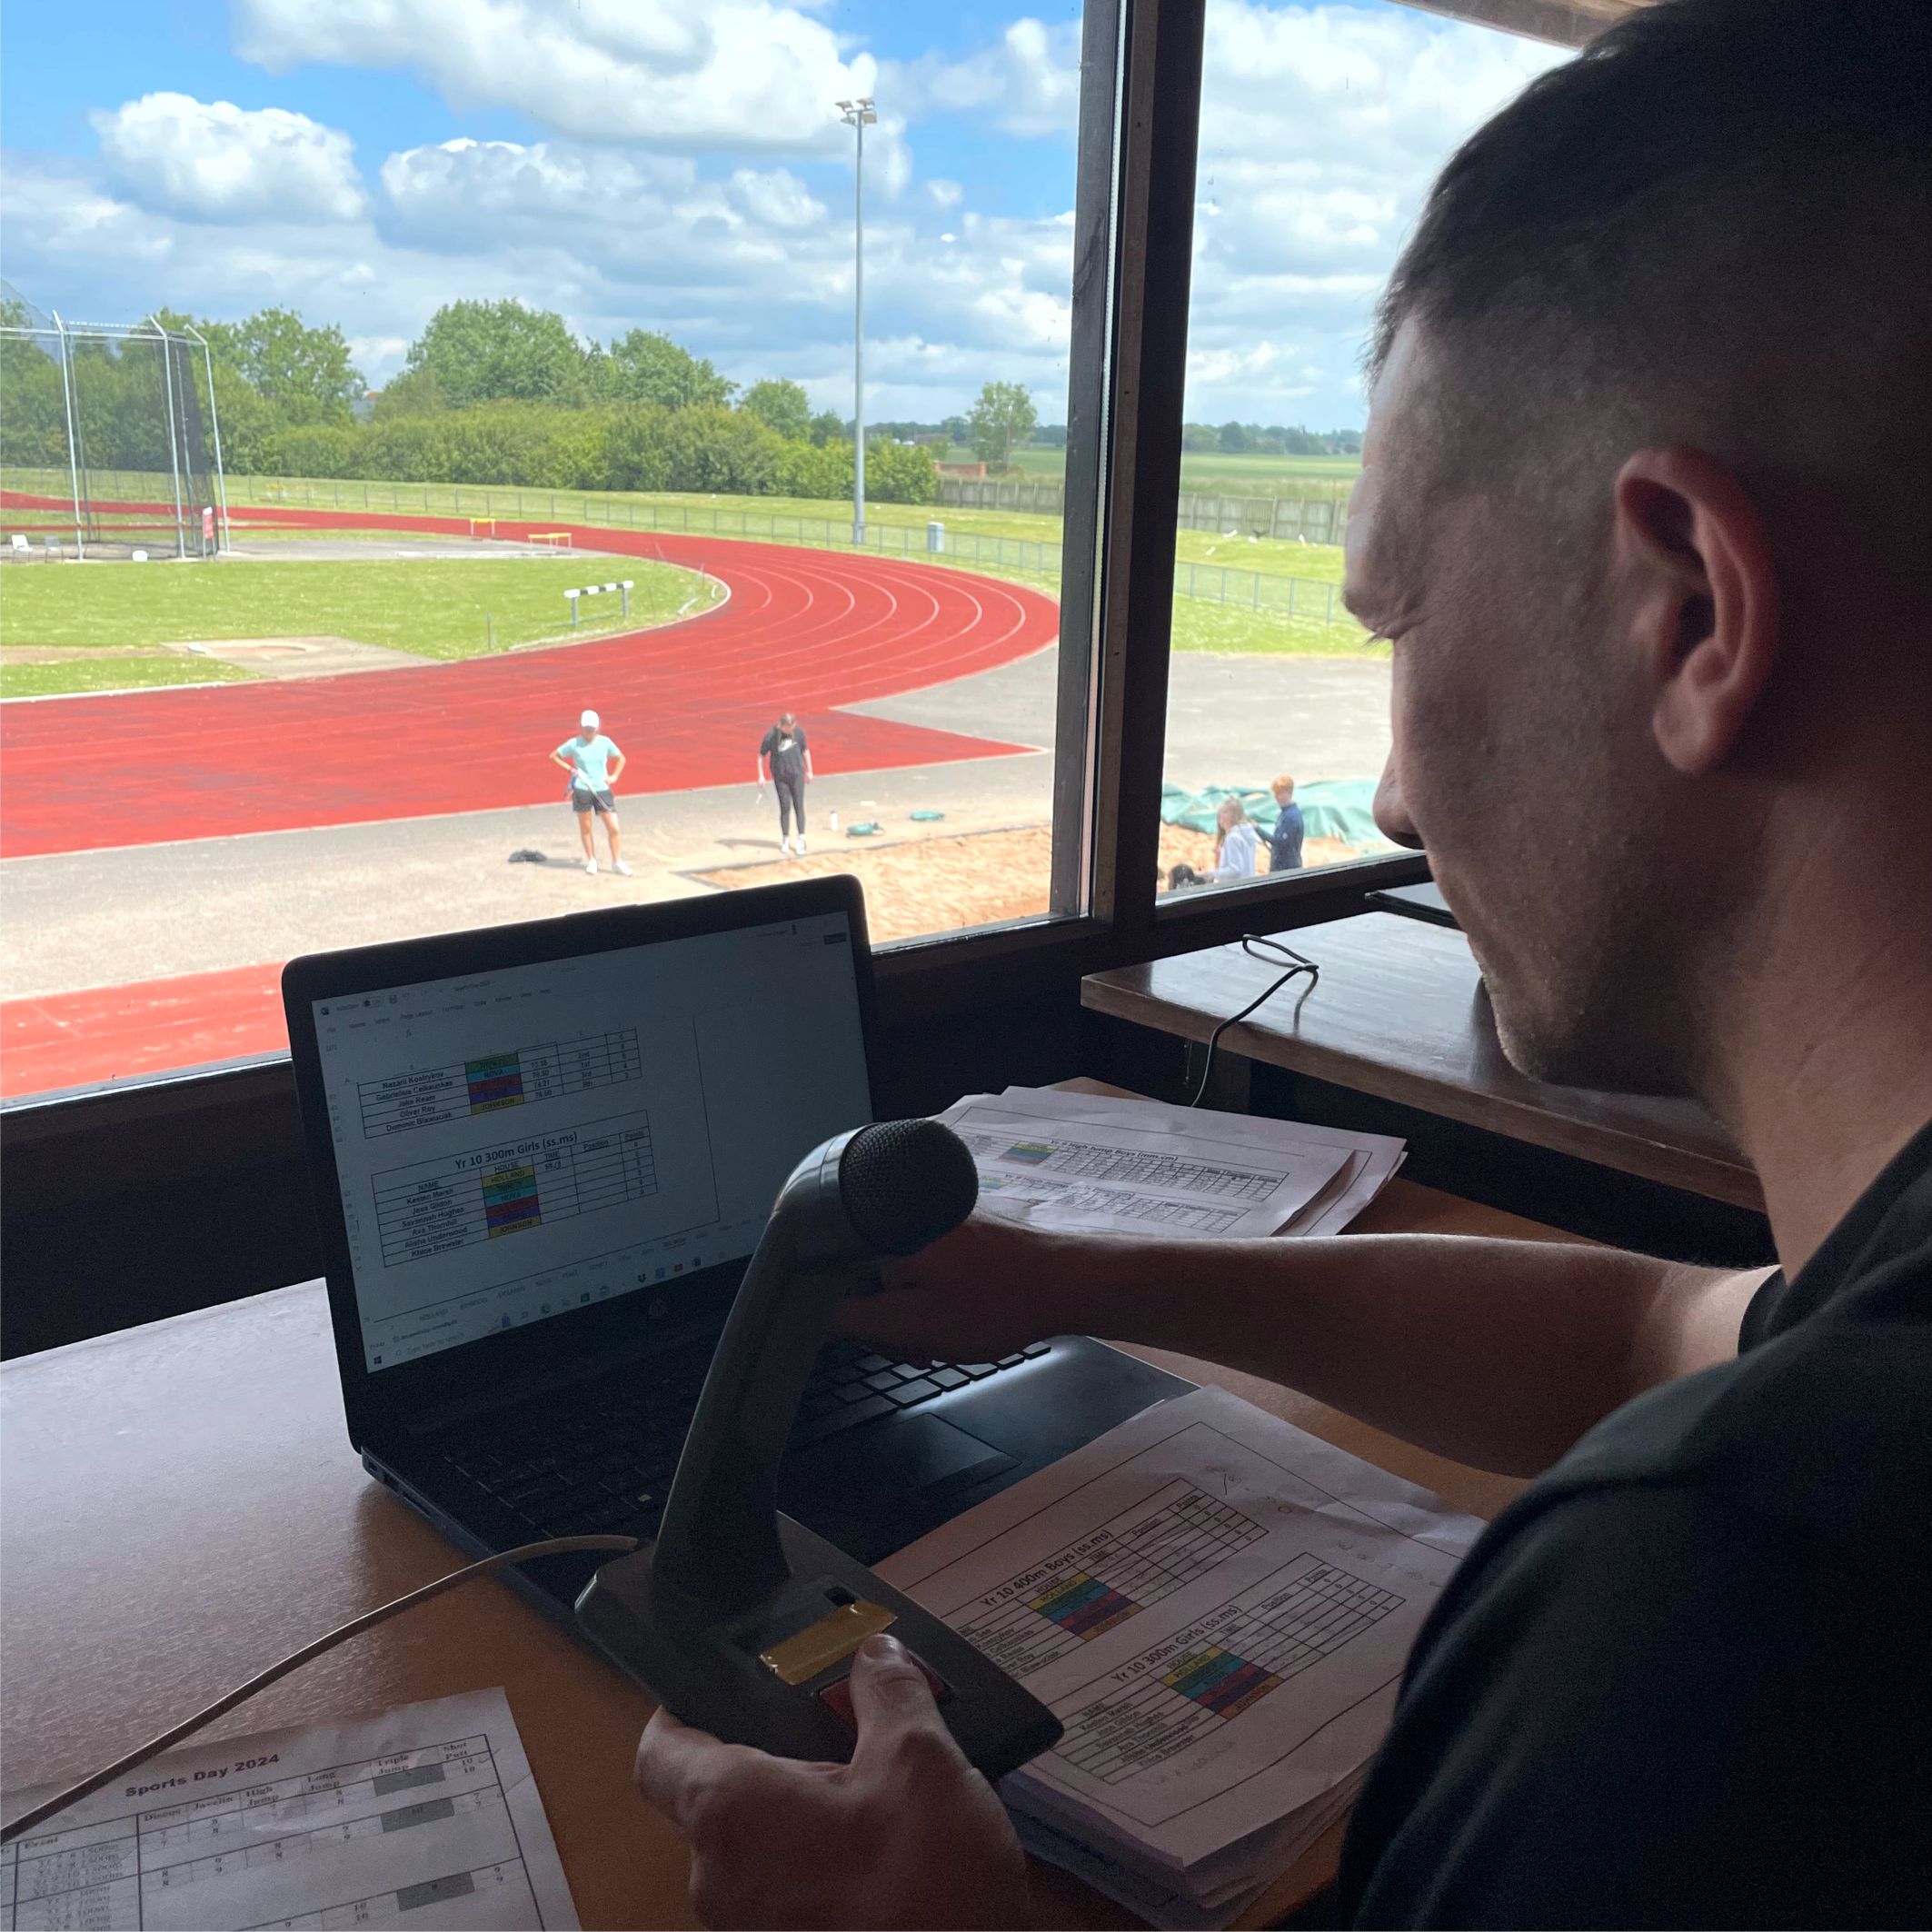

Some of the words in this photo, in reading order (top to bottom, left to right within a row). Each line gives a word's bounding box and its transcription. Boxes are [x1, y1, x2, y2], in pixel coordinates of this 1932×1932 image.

[455, 1160, 466, 1170] Yr
[470, 1155, 483, 1166] 10
[485, 1147, 515, 1162] 300m
[517, 1141, 540, 1154] Girls
[543, 1131, 578, 1150] (ss.ms)
[1090, 1146, 1113, 1154] Jump
[494, 1160, 520, 1172] HOUSE
[418, 1180, 439, 1191] NAME
[1088, 1549, 1107, 1561] TIME
[980, 1596, 998, 1607] Yr
[997, 1587, 1014, 1599] 10
[1013, 1568, 1049, 1589] 400m
[1045, 1552, 1076, 1572] Boys
[1071, 1529, 1114, 1556] (ss.ms)
[1034, 1577, 1063, 1594] HOUSE
[1039, 1578, 1078, 1603] HOLLAND
[1260, 1592, 1293, 1610] Position
[1110, 1672, 1128, 1683] Yr
[1127, 1661, 1146, 1675] 10
[1142, 1643, 1179, 1666] 300m
[1176, 1628, 1205, 1647] Girls
[1199, 1604, 1243, 1633] (ss.ms)
[1167, 1650, 1194, 1669] HOUSE
[1174, 1654, 1211, 1678] HOLLAND
[124, 1776, 187, 1798] Sports
[194, 1767, 228, 1781] Day
[234, 1753, 280, 1772] 2024
[245, 1787, 274, 1798] High
[193, 1795, 234, 1811] Javelin
[246, 1795, 279, 1808] Jump
